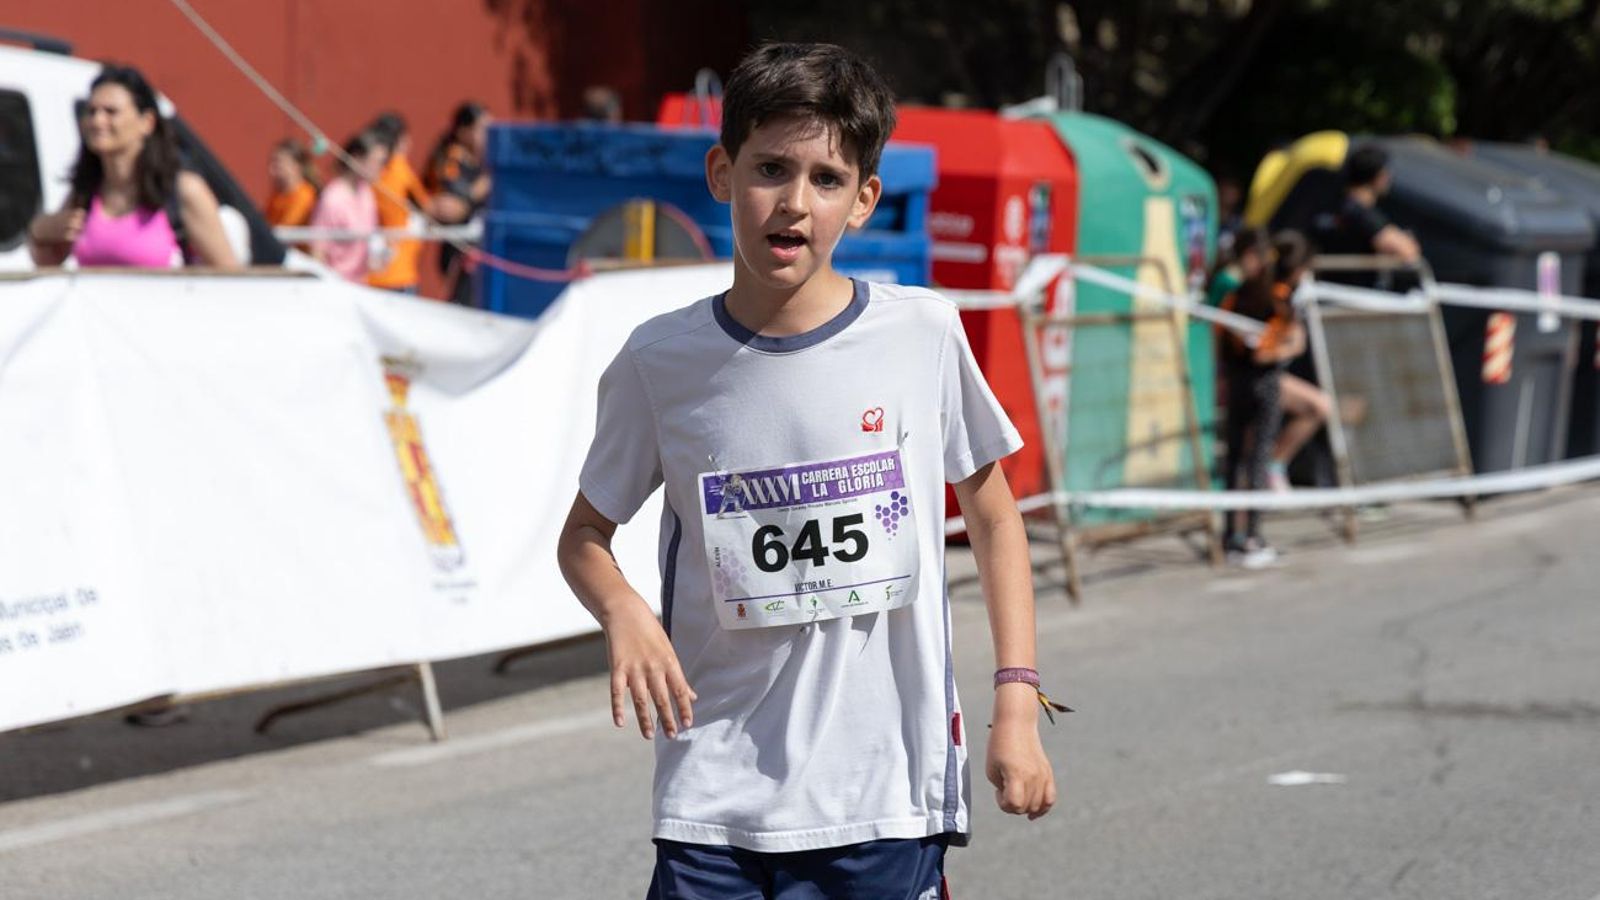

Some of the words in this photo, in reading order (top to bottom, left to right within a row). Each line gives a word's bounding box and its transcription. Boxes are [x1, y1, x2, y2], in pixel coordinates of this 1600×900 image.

[802, 467, 849, 485] CARRERA
[852, 457, 896, 475] ESCOLAR
[739, 473, 801, 505] XXXVI
[812, 484, 828, 498] LA
[838, 473, 885, 494] GLORIA
[752, 513, 869, 573] 645
[794, 581, 818, 593] VICTOR
